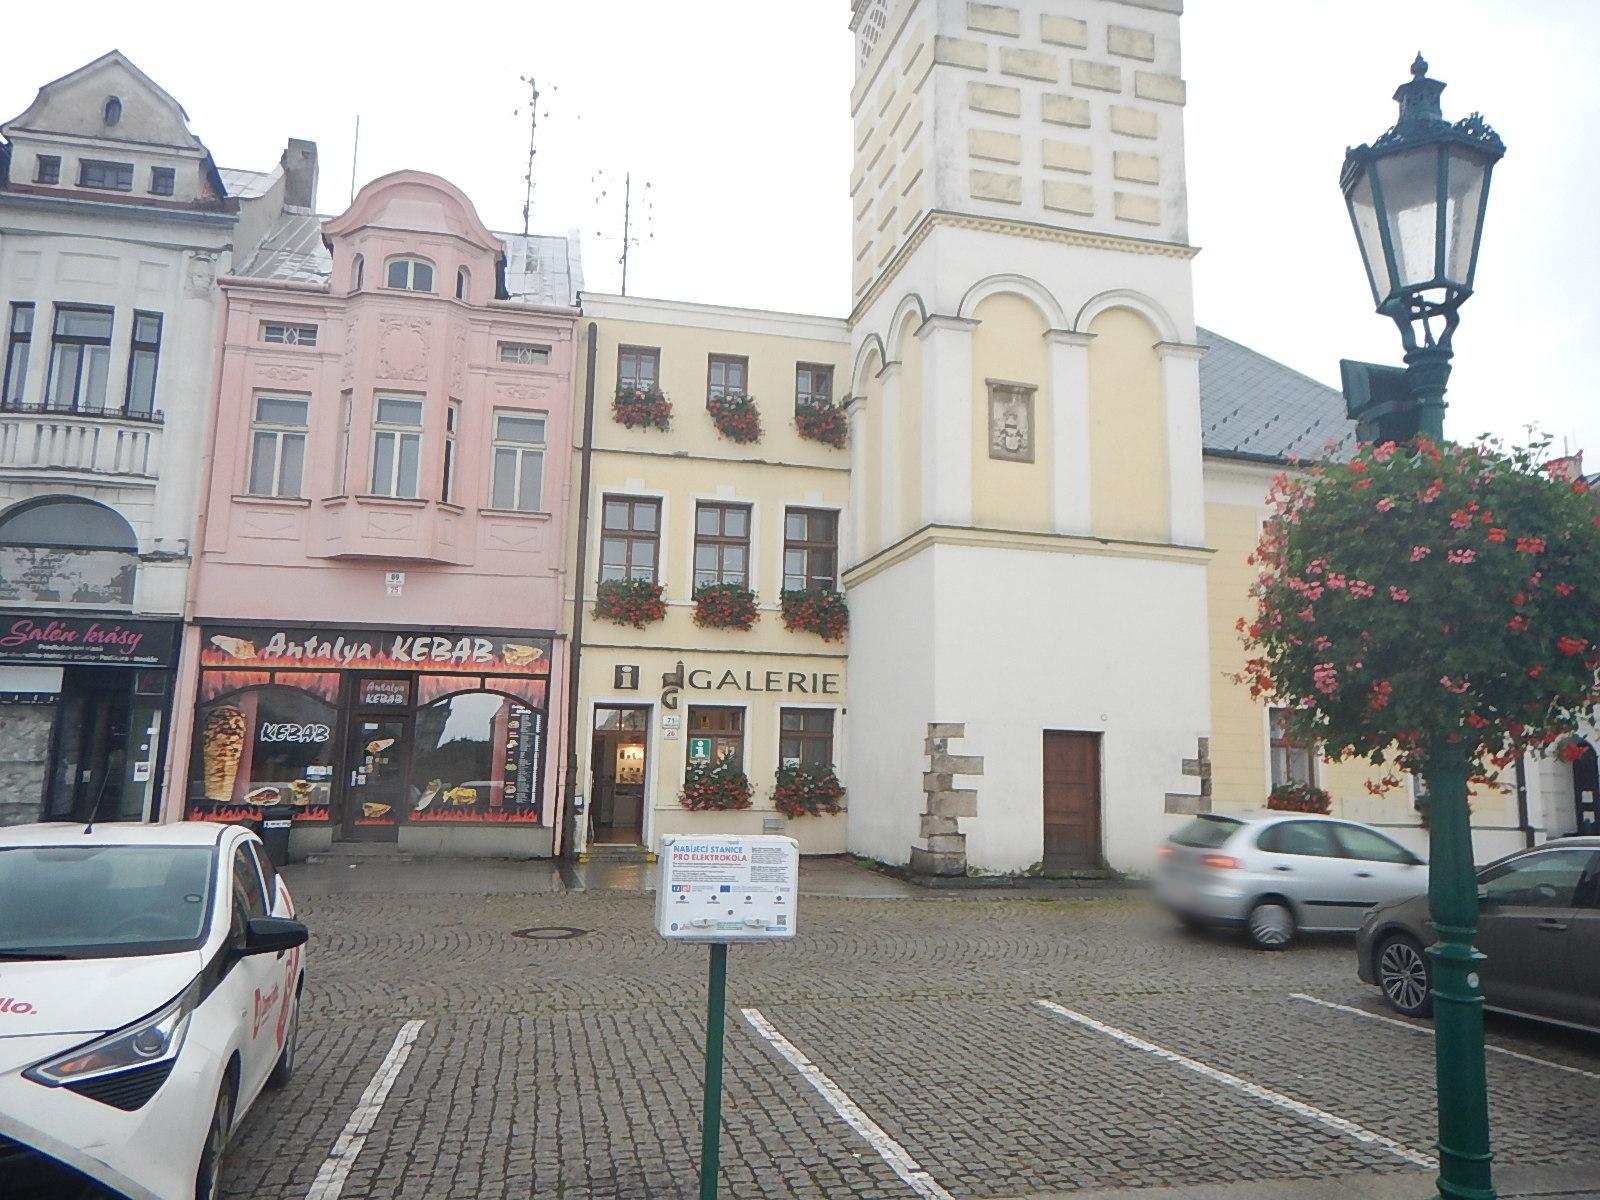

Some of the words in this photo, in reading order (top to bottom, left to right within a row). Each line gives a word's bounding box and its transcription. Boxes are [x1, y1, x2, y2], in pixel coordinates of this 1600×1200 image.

[0, 619, 79, 646] Salón
[83, 622, 144, 655] krásy
[264, 632, 372, 665] Antalya
[391, 635, 494, 663] KEBAB
[366, 681, 405, 693] Antalya
[688, 669, 839, 694] GALERIE
[365, 693, 403, 704] KEBAB
[260, 722, 331, 743] KEBAB
[673, 844, 709, 853] NABÍJECÍ
[710, 846, 743, 854] STANICE
[673, 853, 690, 861] PRO
[691, 854, 748, 862] ELEKTROKOLA
